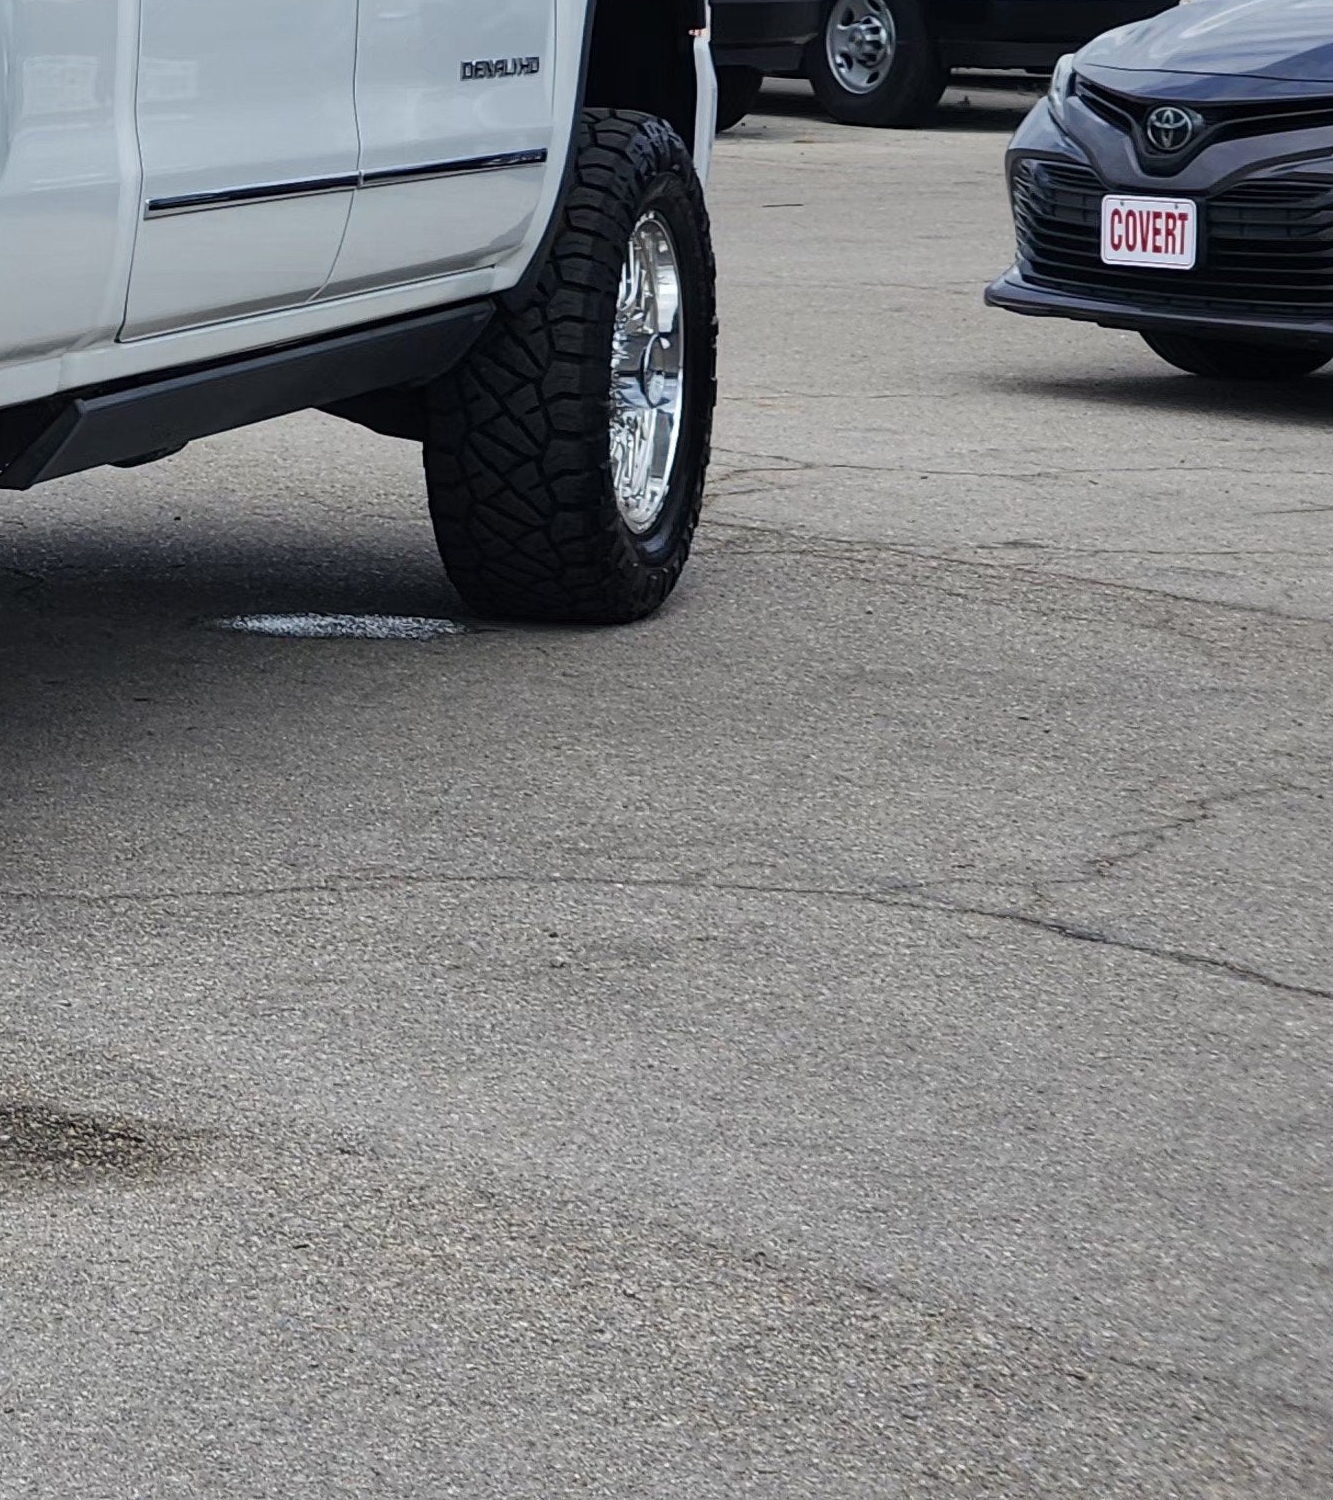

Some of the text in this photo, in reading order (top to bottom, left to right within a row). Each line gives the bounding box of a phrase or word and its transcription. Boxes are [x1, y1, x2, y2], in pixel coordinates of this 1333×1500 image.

[460, 56, 540, 82] DENALI HD
[1109, 208, 1189, 255] COVERT
